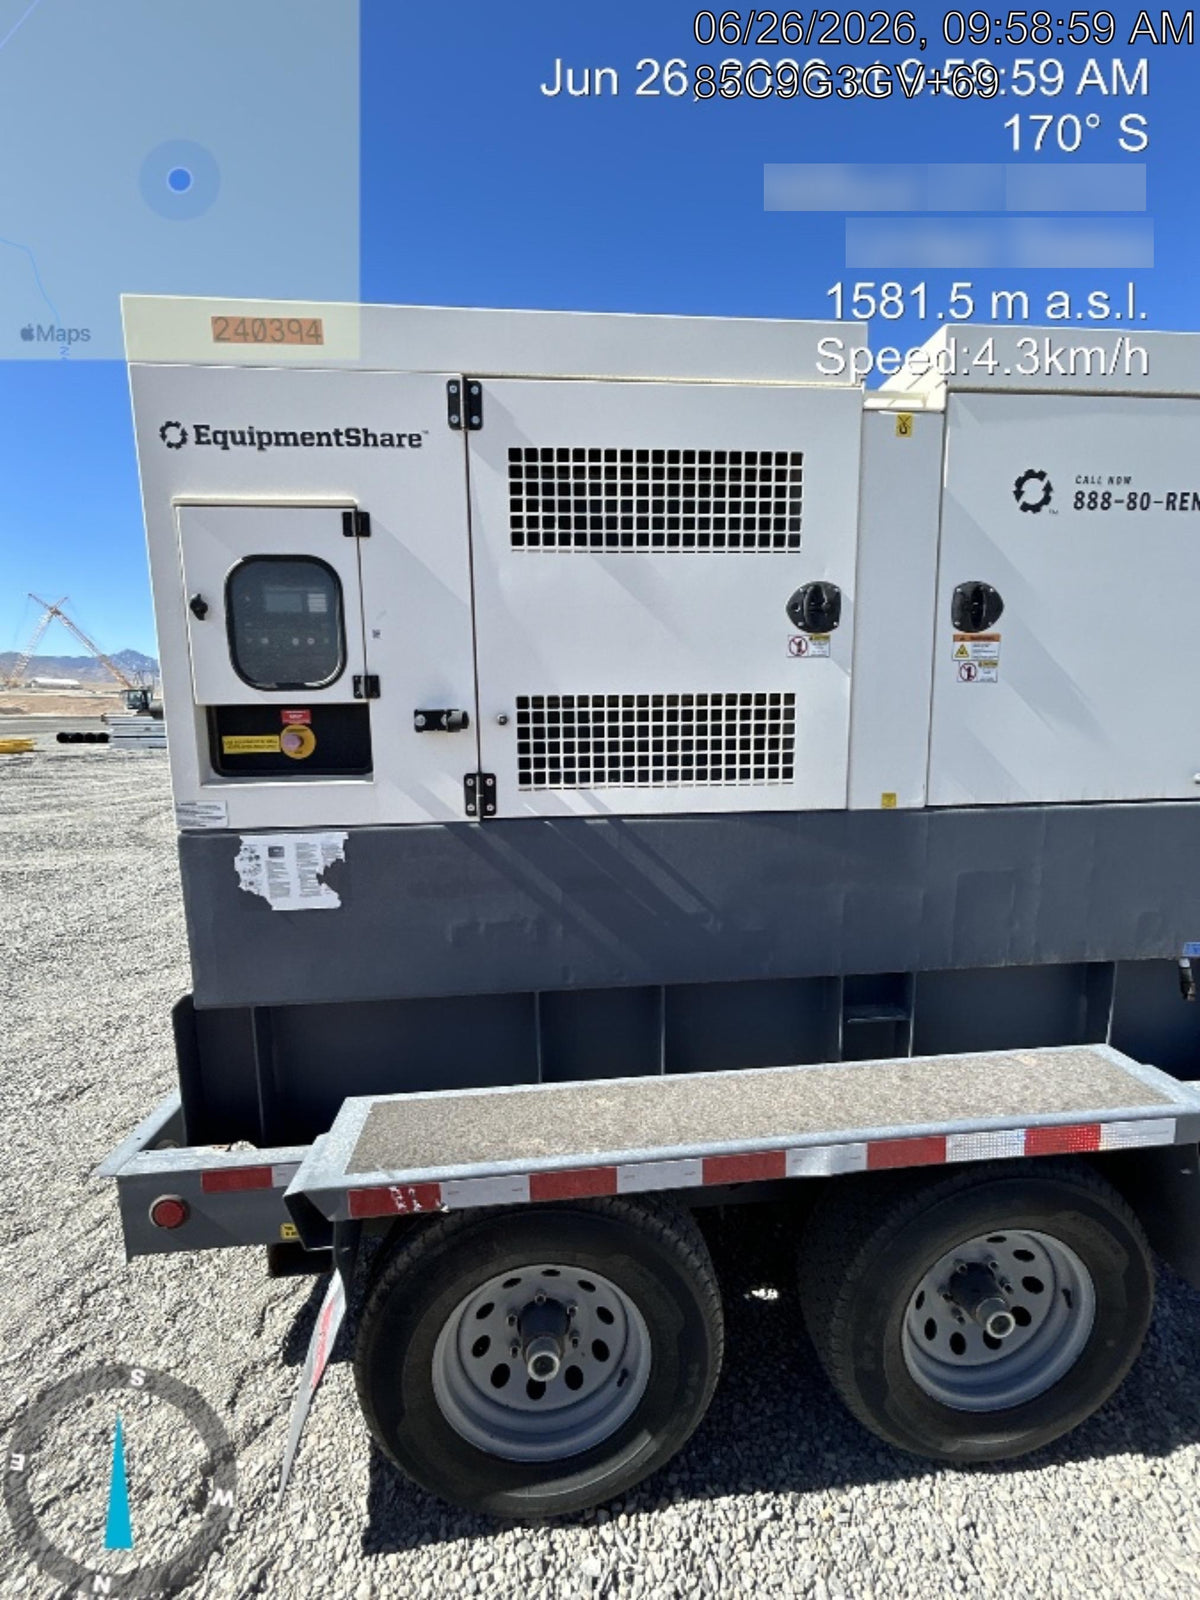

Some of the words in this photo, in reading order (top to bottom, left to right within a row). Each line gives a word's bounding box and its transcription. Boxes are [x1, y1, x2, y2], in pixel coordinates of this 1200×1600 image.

[213, 317, 322, 343] 240394
[193, 424, 422, 451] EquipmentShare
[1075, 475, 1102, 485] CALL
[1107, 476, 1132, 486] NOW
